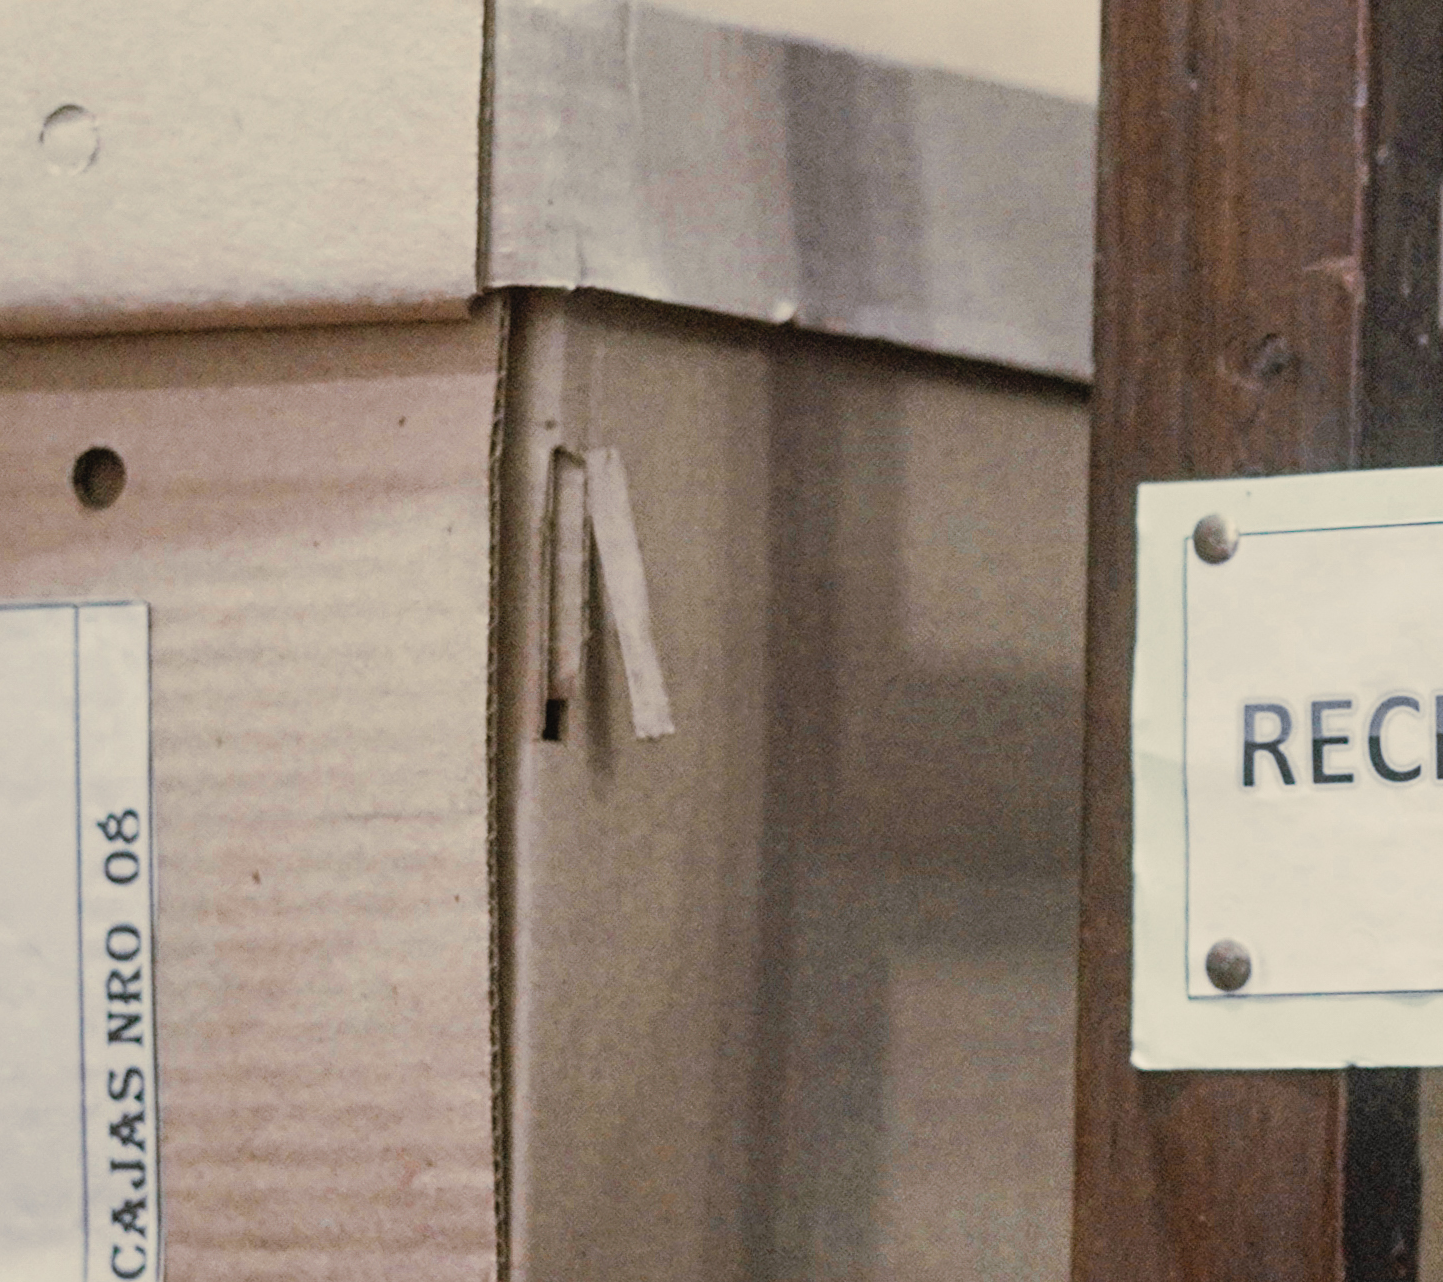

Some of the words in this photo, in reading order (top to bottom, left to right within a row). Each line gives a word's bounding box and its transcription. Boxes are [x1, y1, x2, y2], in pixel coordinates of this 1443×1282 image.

[97, 808, 141, 885] 08
[106, 924, 143, 1046] NRO
[109, 1067, 147, 1279] CAJAS
